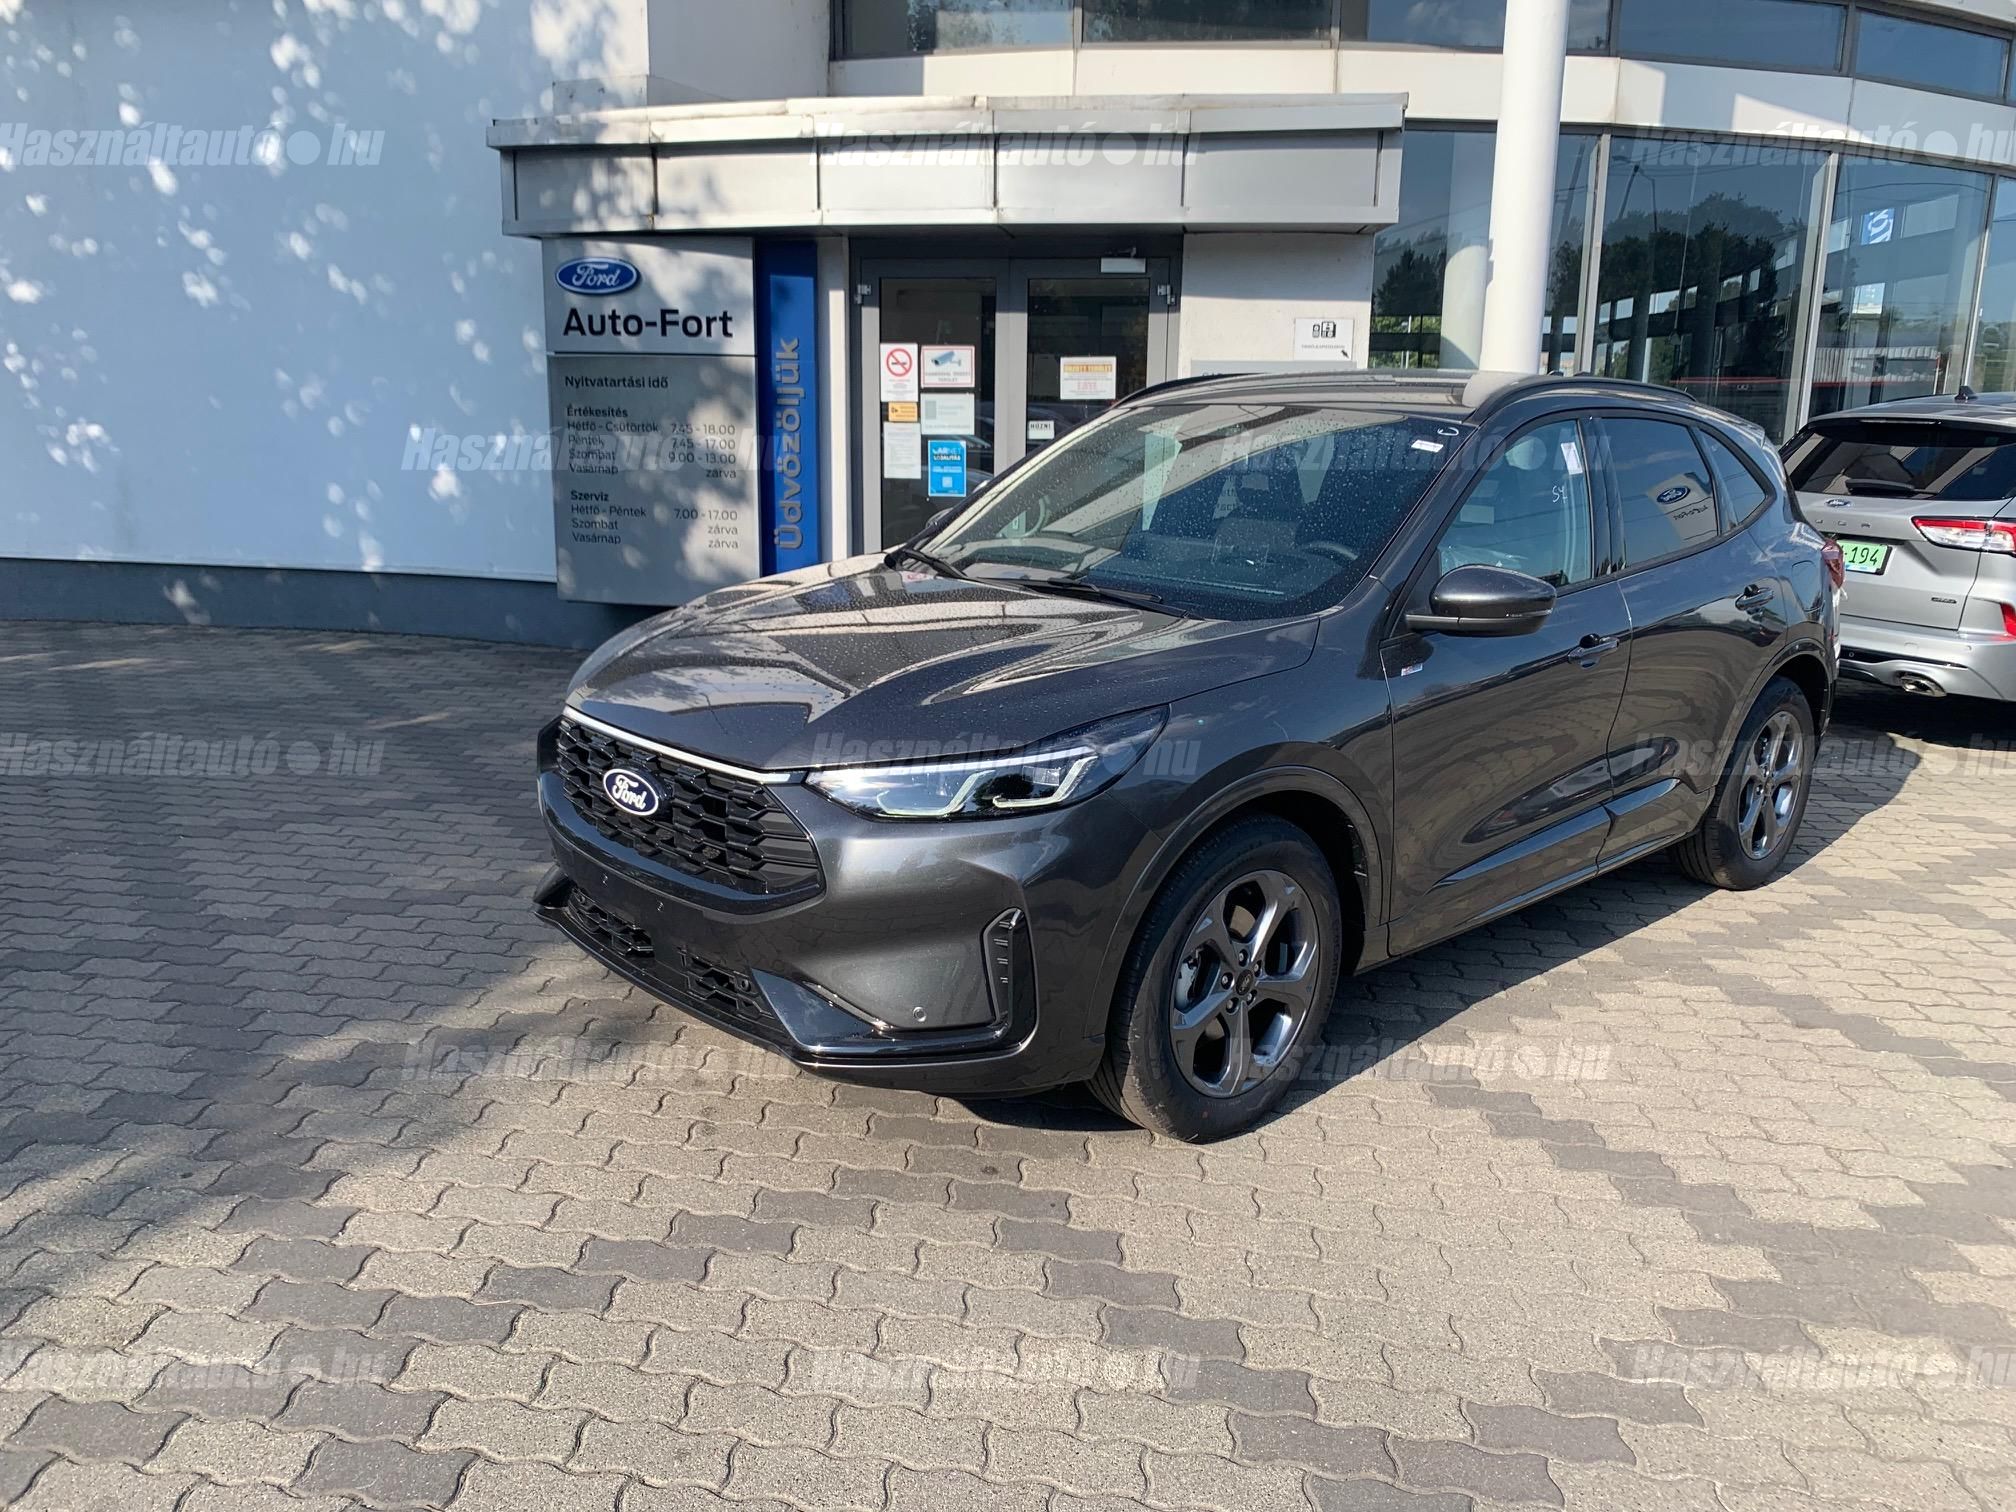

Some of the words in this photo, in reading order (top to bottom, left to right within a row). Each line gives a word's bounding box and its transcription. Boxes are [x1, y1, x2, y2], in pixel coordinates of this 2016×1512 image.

[572, 263, 620, 287] Ford
[563, 307, 733, 338] Auto-Fort
[565, 376, 645, 389] Nyitvatartási
[648, 376, 669, 389] idő
[567, 404, 628, 418] Értékesítés
[567, 420, 597, 432] Hétfő
[605, 421, 659, 433] Csütörtök
[703, 424, 736, 435] 18.00
[568, 435, 604, 446] Péntek
[704, 439, 736, 450] 17.00
[770, 337, 806, 551] Üdvözöljük
[568, 450, 616, 461] Szombat
[668, 451, 694, 462] 9.00
[705, 453, 737, 464] 13.00
[570, 463, 619, 475] Vasárnap
[705, 468, 737, 479] zárva
[570, 491, 609, 502] Szerviz
[571, 504, 600, 515] Hétfő
[609, 505, 647, 517] Péntek
[674, 508, 698, 519] 7.00
[708, 510, 738, 521] 17.00
[572, 519, 618, 530] Szombat
[707, 525, 738, 536] zárva
[572, 532, 621, 544] Vasárnap
[708, 538, 739, 549] zárva
[1842, 545, 1879, 566] -194
[612, 774, 647, 810] Ford
